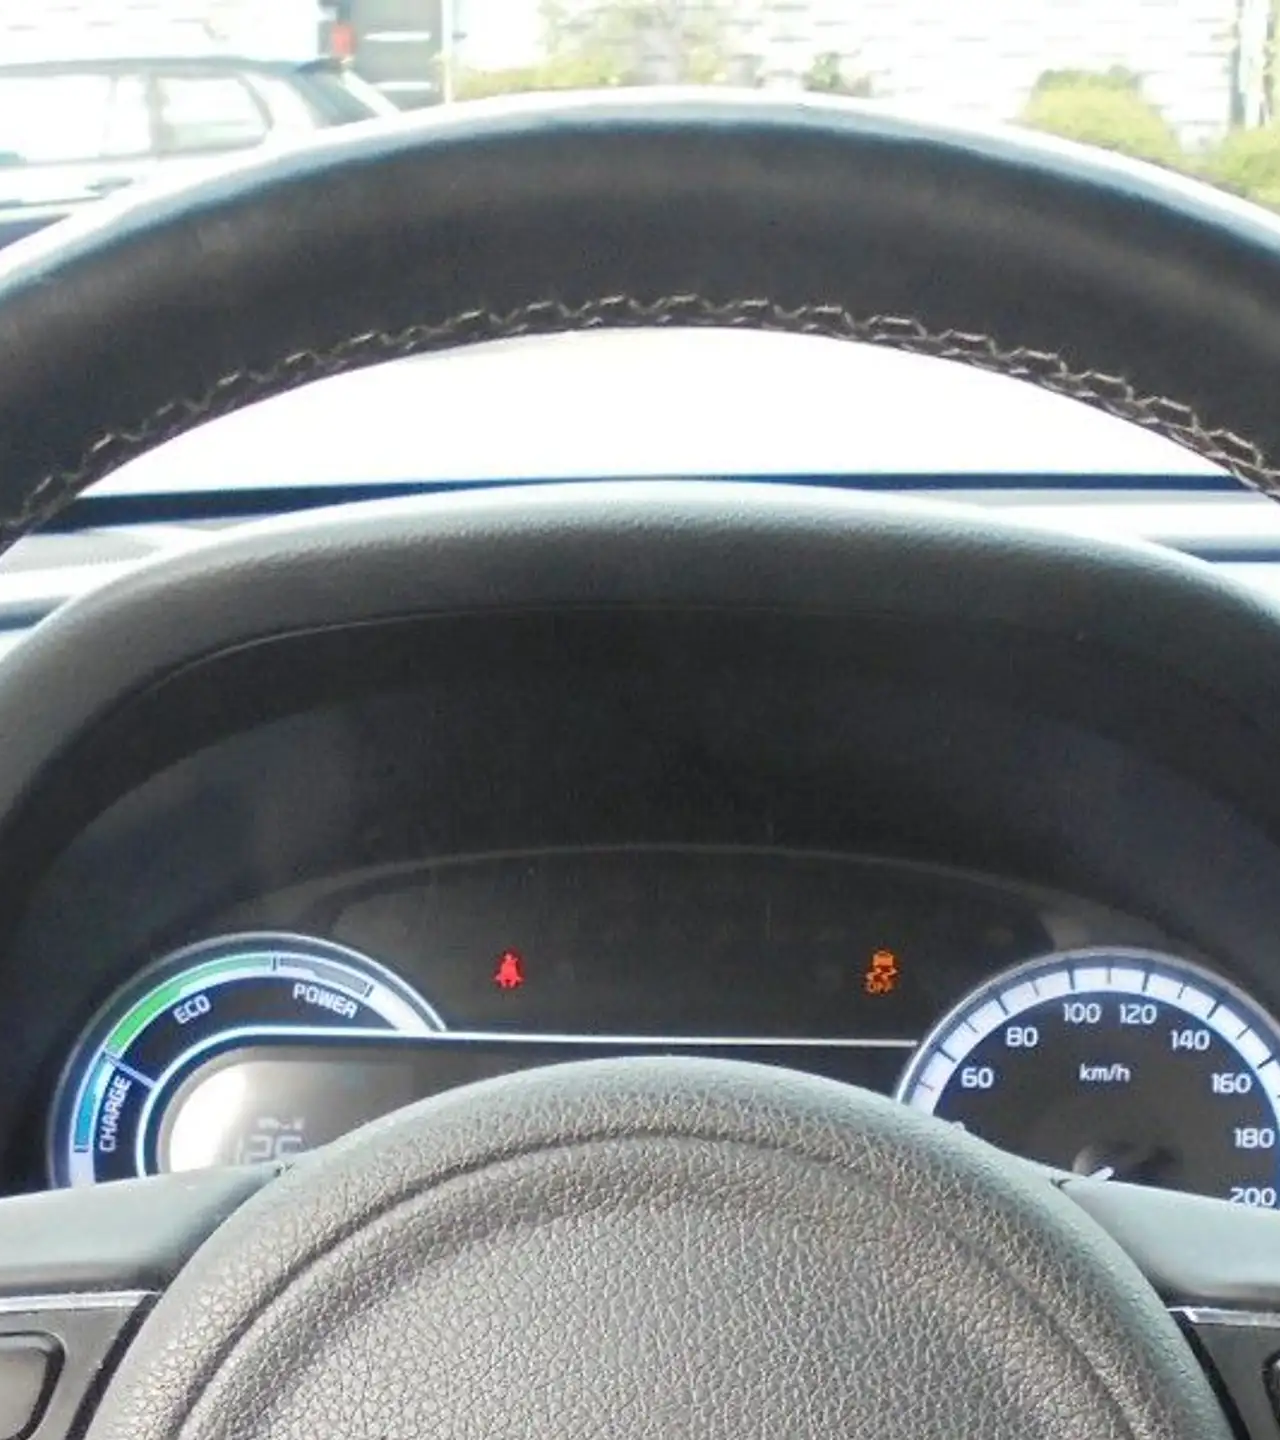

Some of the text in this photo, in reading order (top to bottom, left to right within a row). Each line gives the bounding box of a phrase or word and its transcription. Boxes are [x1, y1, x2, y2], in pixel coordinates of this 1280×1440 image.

[173, 996, 211, 1025] ECO
[293, 983, 358, 1019] POWER
[1063, 1003, 1101, 1024] 100
[1120, 1004, 1157, 1025] 120
[1006, 1027, 1038, 1047] 80
[1171, 1030, 1210, 1051] 140
[961, 1067, 994, 1089] 60
[1079, 1063, 1131, 1082] km/h
[1212, 1073, 1252, 1094] 160
[99, 1075, 132, 1153] CHARGE
[1234, 1128, 1275, 1149] 180
[1230, 1187, 1276, 1207] 200
